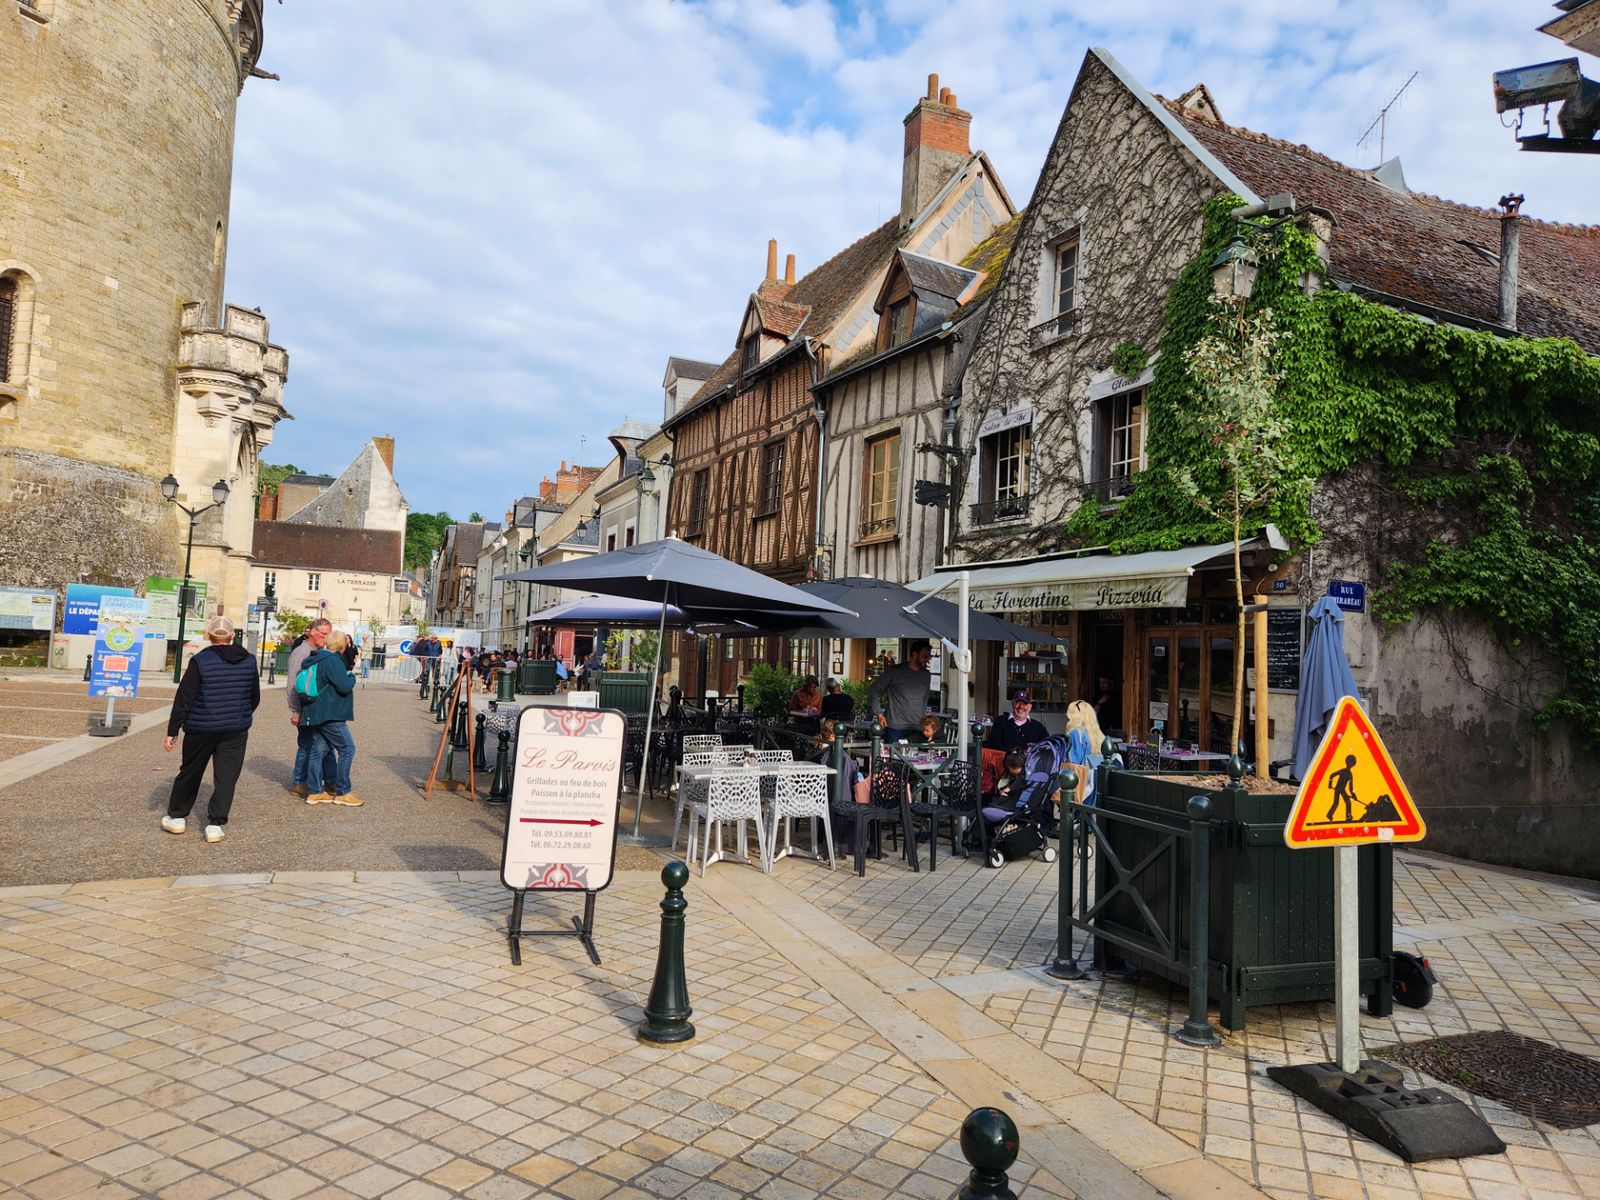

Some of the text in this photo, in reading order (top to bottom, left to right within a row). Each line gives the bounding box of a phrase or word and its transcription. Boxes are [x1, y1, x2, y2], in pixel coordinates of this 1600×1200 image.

[1341, 586, 1354, 595] RUE
[992, 591, 1072, 610] Florentine
[1096, 585, 1166, 606] Pizzeria
[521, 747, 616, 772] Le Parvis
[526, 777, 558, 786] Grillades
[569, 779, 581, 787] feu
[582, 779, 592, 787] de
[592, 780, 608, 788] bois
[531, 789, 558, 798] Poisson
[565, 790, 573, 798] la
[573, 791, 601, 800] plancha
